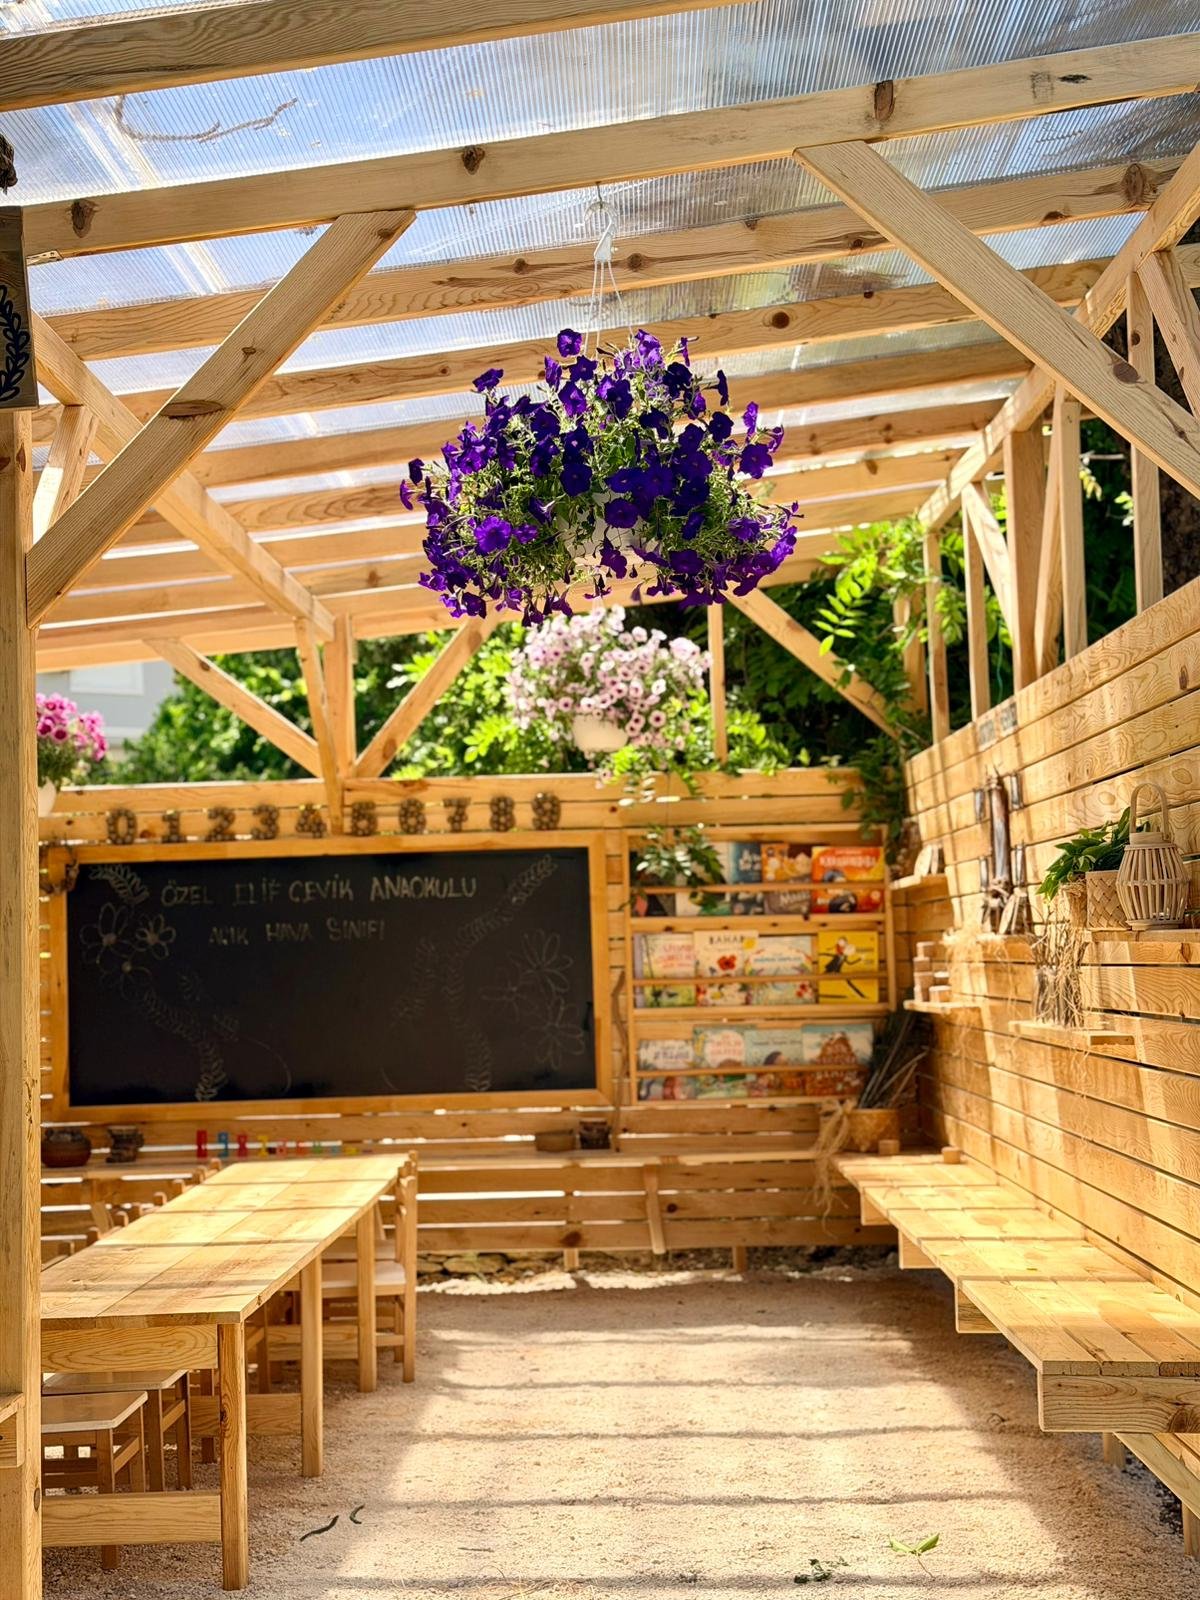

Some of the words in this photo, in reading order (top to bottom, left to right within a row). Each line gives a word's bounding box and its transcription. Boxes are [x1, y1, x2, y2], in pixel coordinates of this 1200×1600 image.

[106, 808, 137, 845] 0
[160, 810, 187, 843] 1
[205, 807, 236, 842] 2
[251, 804, 280, 839] 3
[295, 803, 327, 838] 4
[351, 801, 378, 836] 5
[399, 798, 427, 834] 6
[442, 797, 471, 832] 7
[490, 795, 516, 832] 8
[532, 792, 562, 831] 9
[160, 879, 215, 907] ÖZEL
[370, 875, 478, 901] ANAOKULU
[264, 922, 313, 943] HAVA
